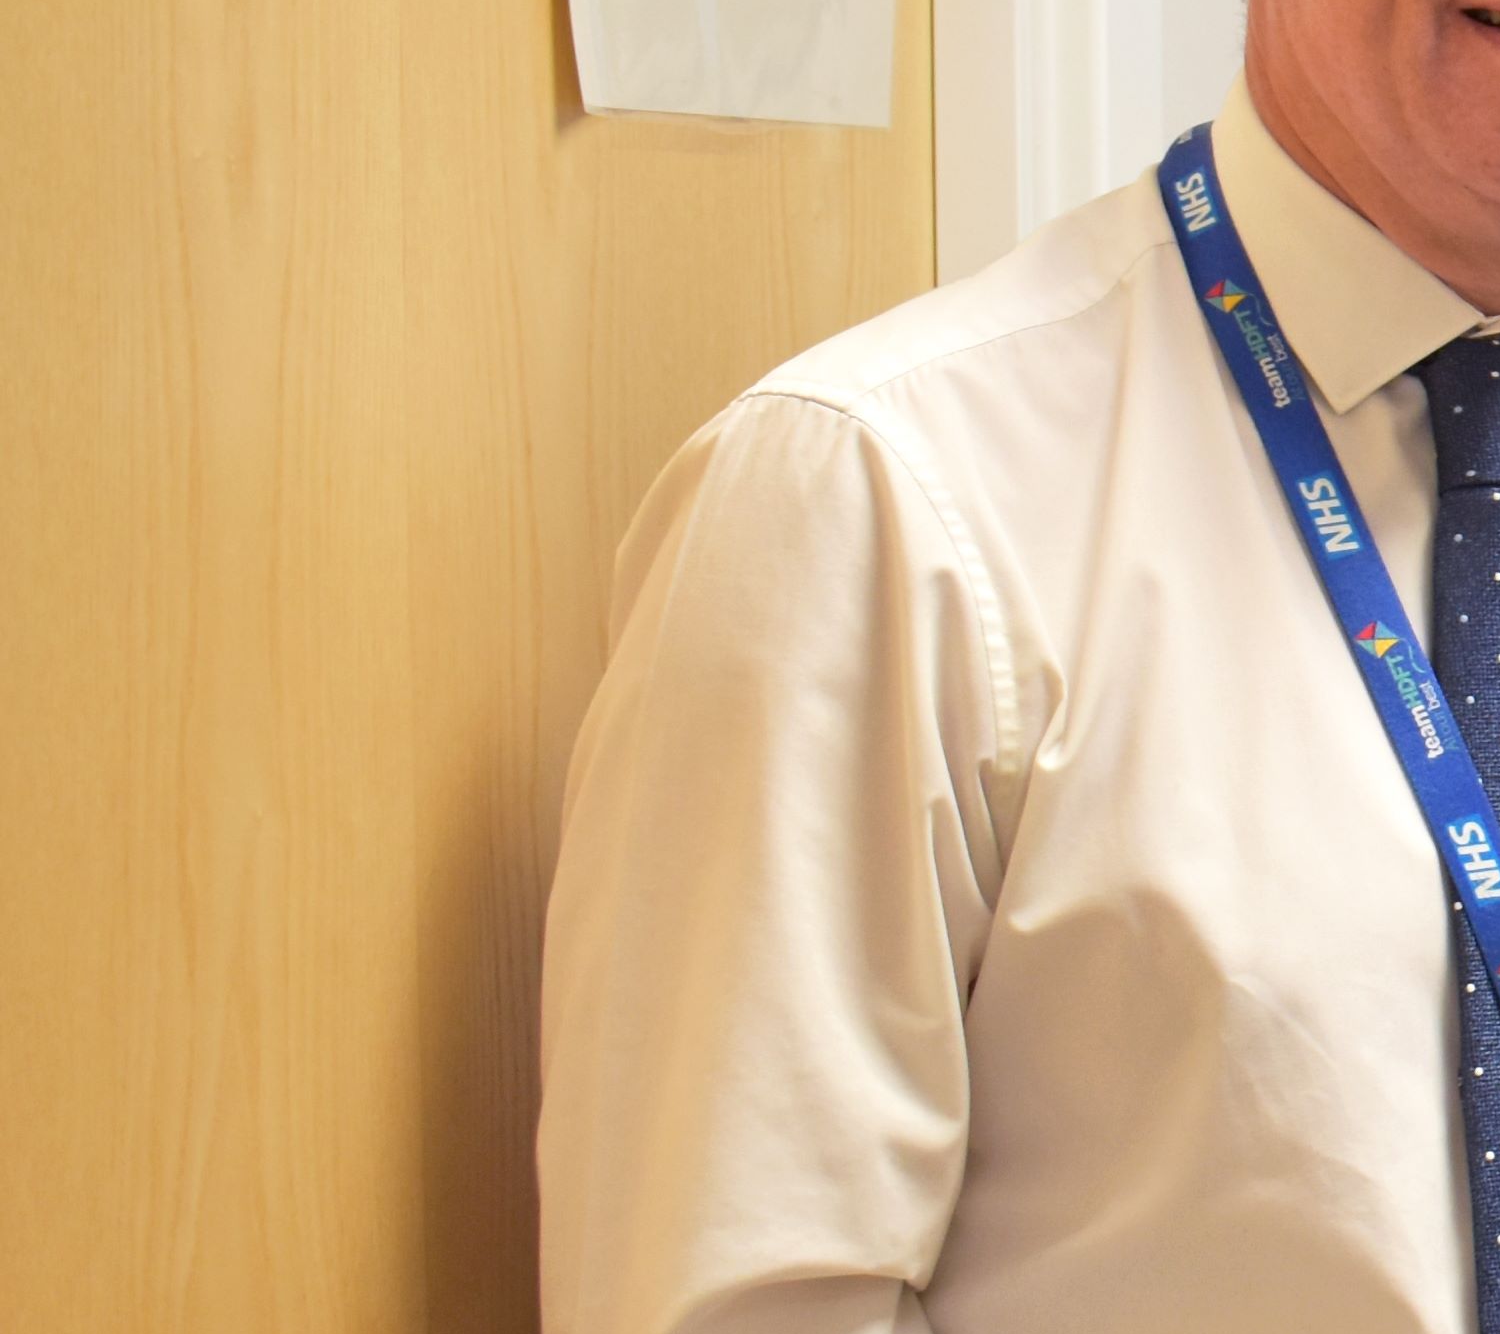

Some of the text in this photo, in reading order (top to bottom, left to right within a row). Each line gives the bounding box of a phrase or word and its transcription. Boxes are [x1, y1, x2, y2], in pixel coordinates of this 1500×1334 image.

[1175, 171, 1217, 233] NHS
[1233, 310, 1291, 409] teamHDFT
[1300, 478, 1359, 553] NHS
[1386, 655, 1444, 759] teamHDFT
